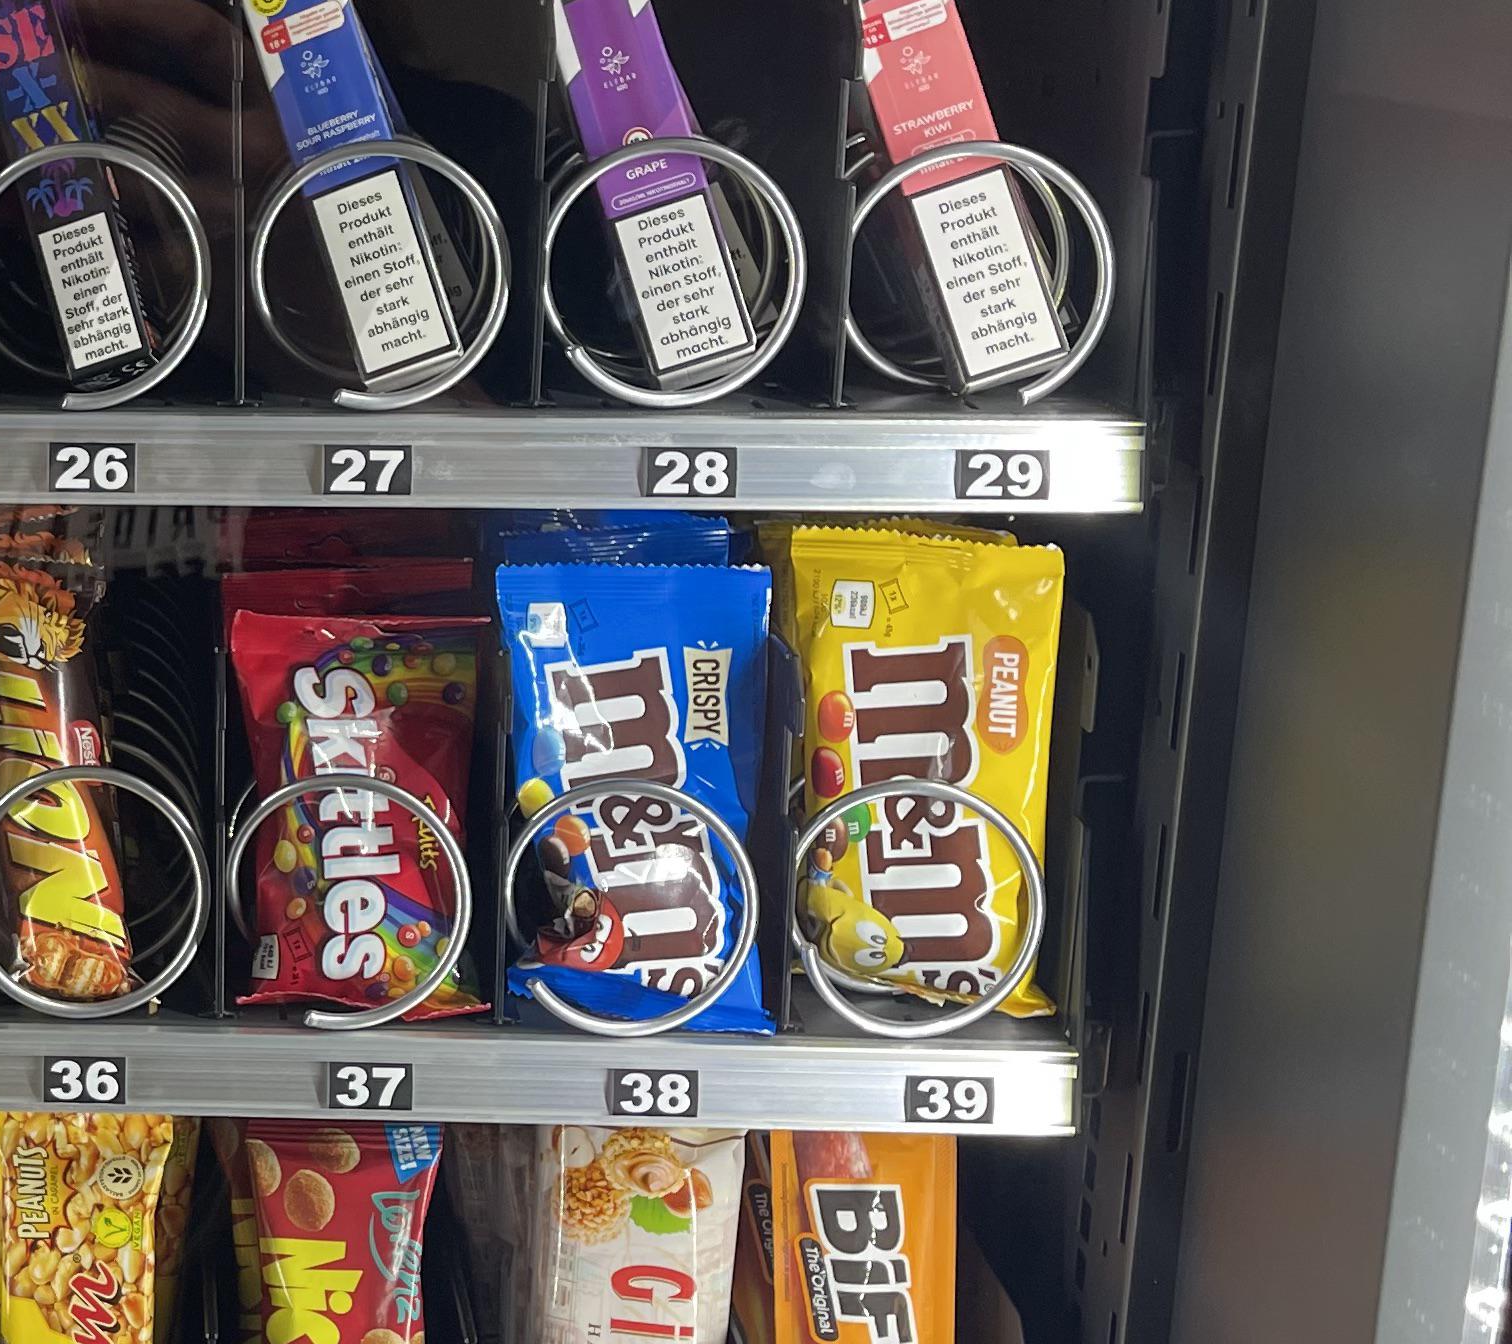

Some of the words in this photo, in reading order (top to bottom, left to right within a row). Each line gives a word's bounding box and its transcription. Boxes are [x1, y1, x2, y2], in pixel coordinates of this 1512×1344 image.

[296, 135, 322, 151] SOUR
[322, 113, 376, 141] RASPBERRY
[308, 110, 360, 136] BLUEBERRY
[893, 99, 974, 135] STRAWBERRY
[924, 122, 953, 139] KIWI
[625, 158, 669, 181] GRAPE
[938, 191, 987, 215] Dieses
[940, 206, 998, 234] Produkt
[950, 224, 1000, 250] enthält
[952, 242, 1008, 268] Nikotin:
[946, 269, 985, 290] einen
[988, 255, 1028, 276] Stoff,
[962, 287, 986, 304] der
[989, 276, 1021, 296] sehr
[970, 311, 1038, 341] abhängig
[980, 297, 1017, 318] stark
[985, 331, 1034, 355] macht.
[54, 446, 129, 490] 26
[329, 449, 405, 492] 27
[652, 451, 729, 495] 28
[965, 453, 1043, 497] 29
[691, 657, 725, 737] CRISPY
[988, 651, 1020, 739] PEANUT
[295, 665, 401, 982] Skittles
[49, 1060, 119, 1101] 36
[335, 1066, 406, 1107] 37
[619, 1072, 691, 1115] 38
[916, 1078, 988, 1121] 39
[12, 1144, 51, 1240] PEANUTS
[810, 1268, 834, 1336] Original
